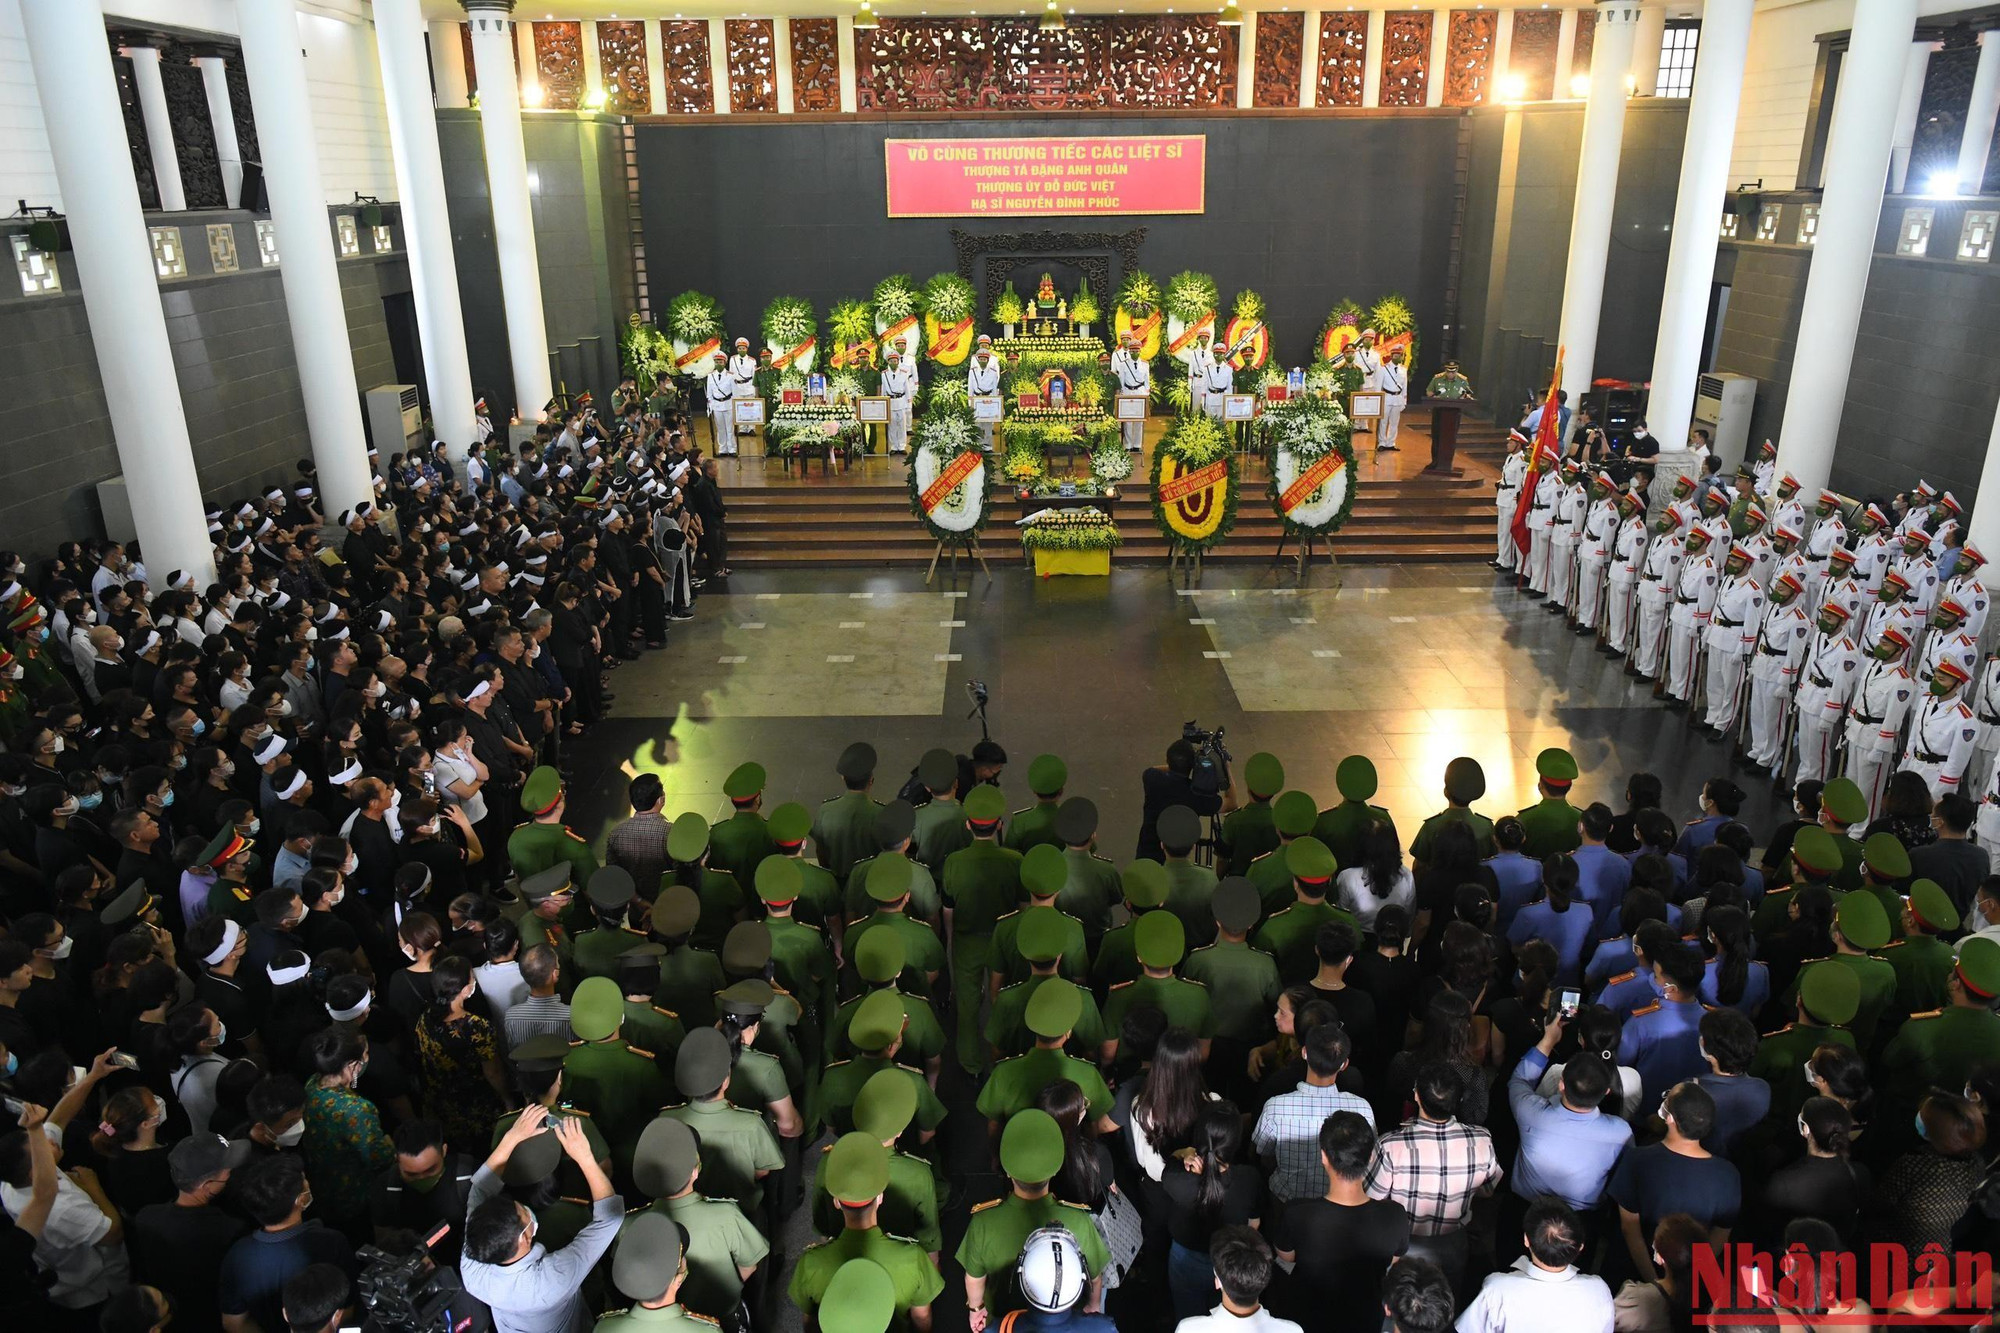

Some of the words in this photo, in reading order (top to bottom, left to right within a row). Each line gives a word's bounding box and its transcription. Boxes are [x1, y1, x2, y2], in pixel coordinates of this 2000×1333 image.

[907, 145, 929, 161] VÔ
[933, 145, 978, 161] CÙNG
[982, 145, 1047, 160] THƯƠNG
[1052, 142, 1086, 160] TIẾC
[1091, 143, 1124, 160] CÁC
[1128, 142, 1162, 161] LIỆT
[1166, 142, 1184, 159] SĨ
[963, 165, 1010, 178] THƯỢNG
[1013, 163, 1028, 176] TÁ
[1031, 163, 1064, 178] ĐẶNG
[1067, 164, 1092, 176] ANH
[1095, 162, 1128, 176] QUÂN
[976, 181, 1023, 194] THƯỢNG
[1044, 178, 1060, 192] ĐỖ
[1063, 179, 1087, 192] ĐỨC
[1091, 179, 1116, 194] VIỆT
[971, 198, 987, 211] HẠ
[990, 196, 1003, 209] SĨ
[1005, 195, 1053, 210] NGUYỄN
[1056, 196, 1085, 209] ĐÌNH
[1088, 196, 1120, 208] PHÚC
